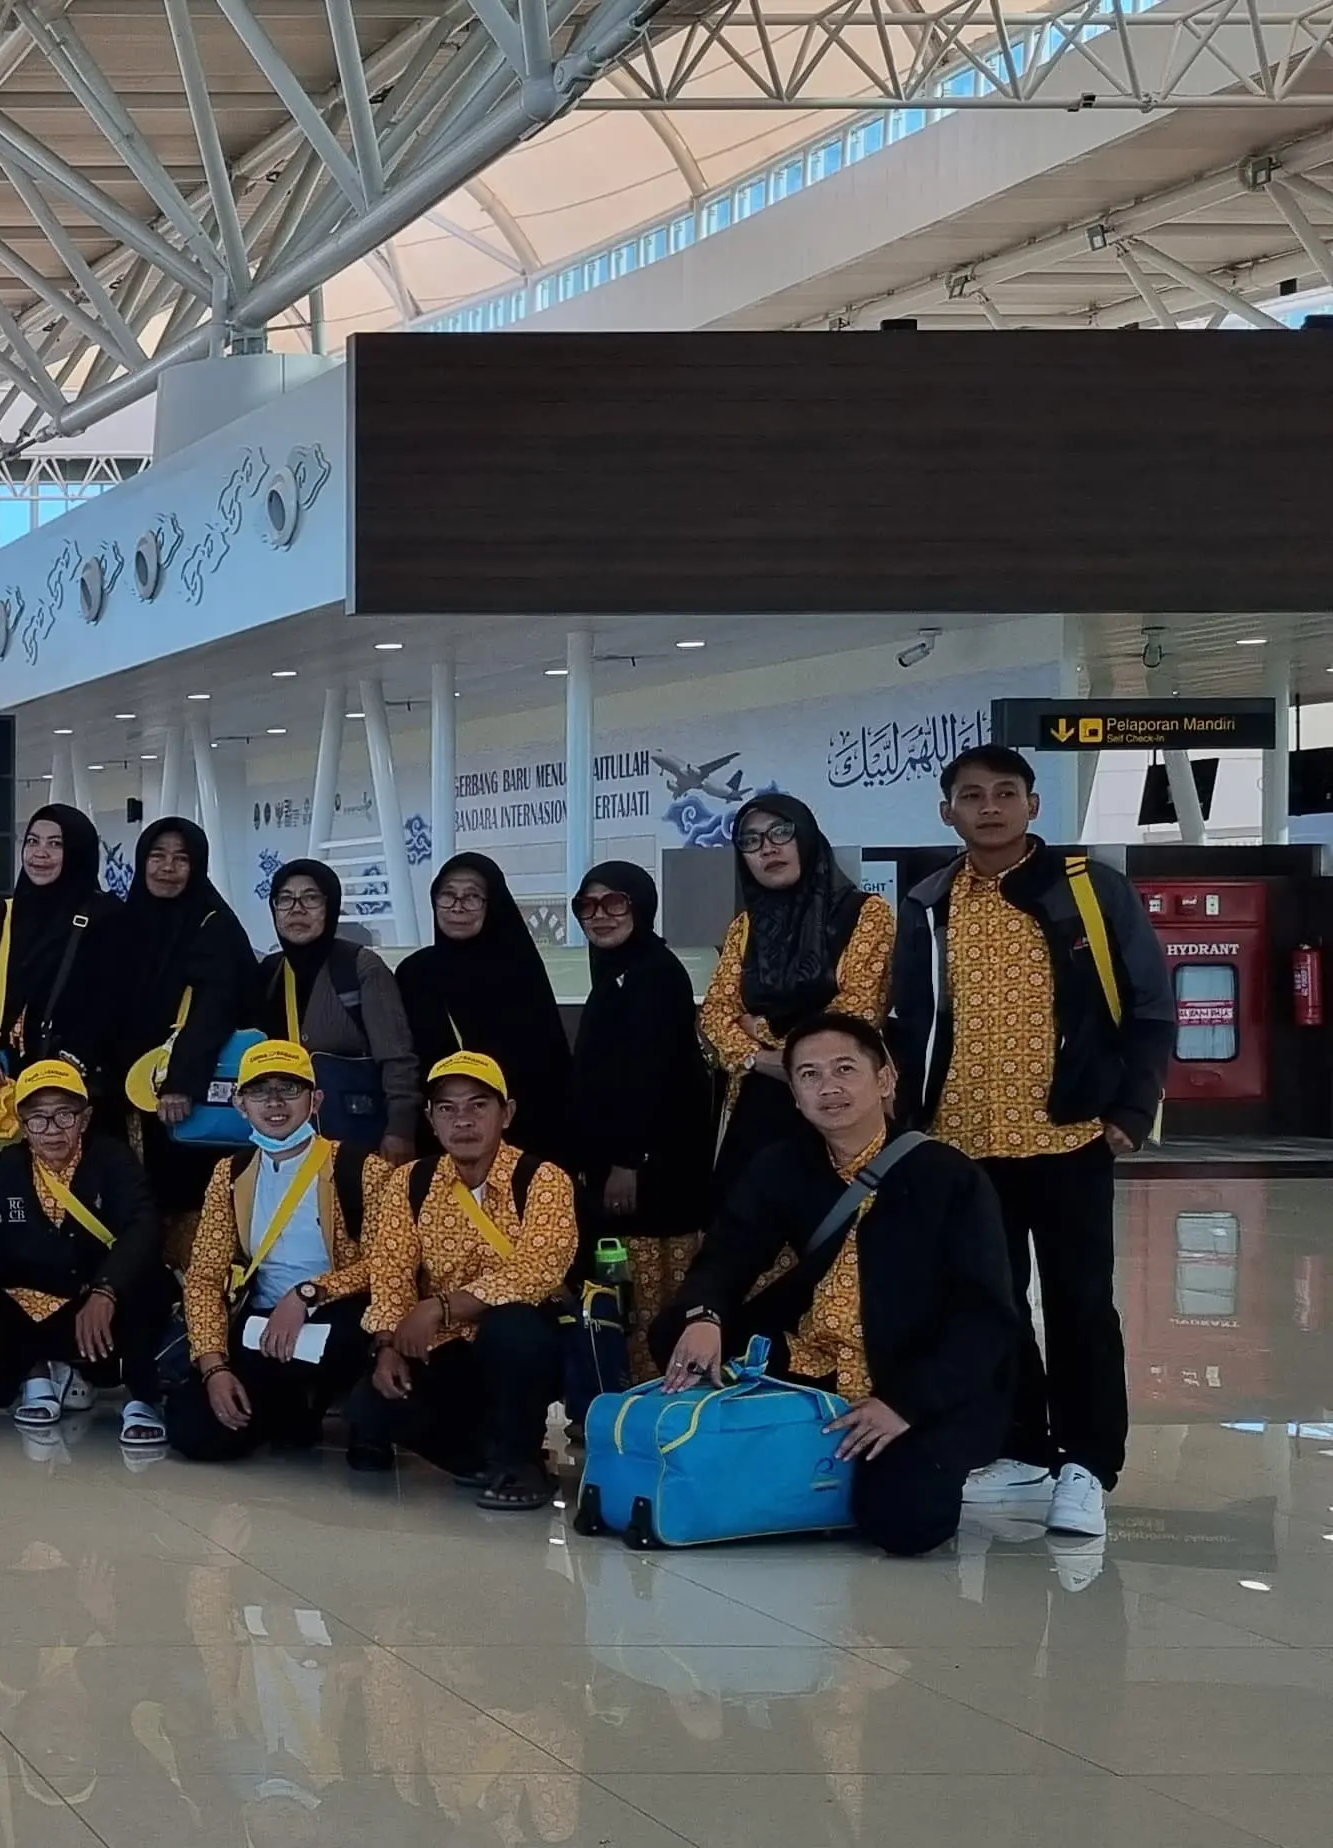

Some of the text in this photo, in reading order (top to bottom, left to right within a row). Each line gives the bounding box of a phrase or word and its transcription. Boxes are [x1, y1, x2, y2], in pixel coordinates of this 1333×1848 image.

[1106, 717, 1179, 734] Pelaporan
[503, 766, 531, 792] BARU
[535, 762, 567, 788] MENU
[593, 750, 650, 781] AITULLAH
[455, 791, 650, 833] BANDARA INTERNASION ERTAJATI
[1166, 943, 1240, 956] HYDRANT
